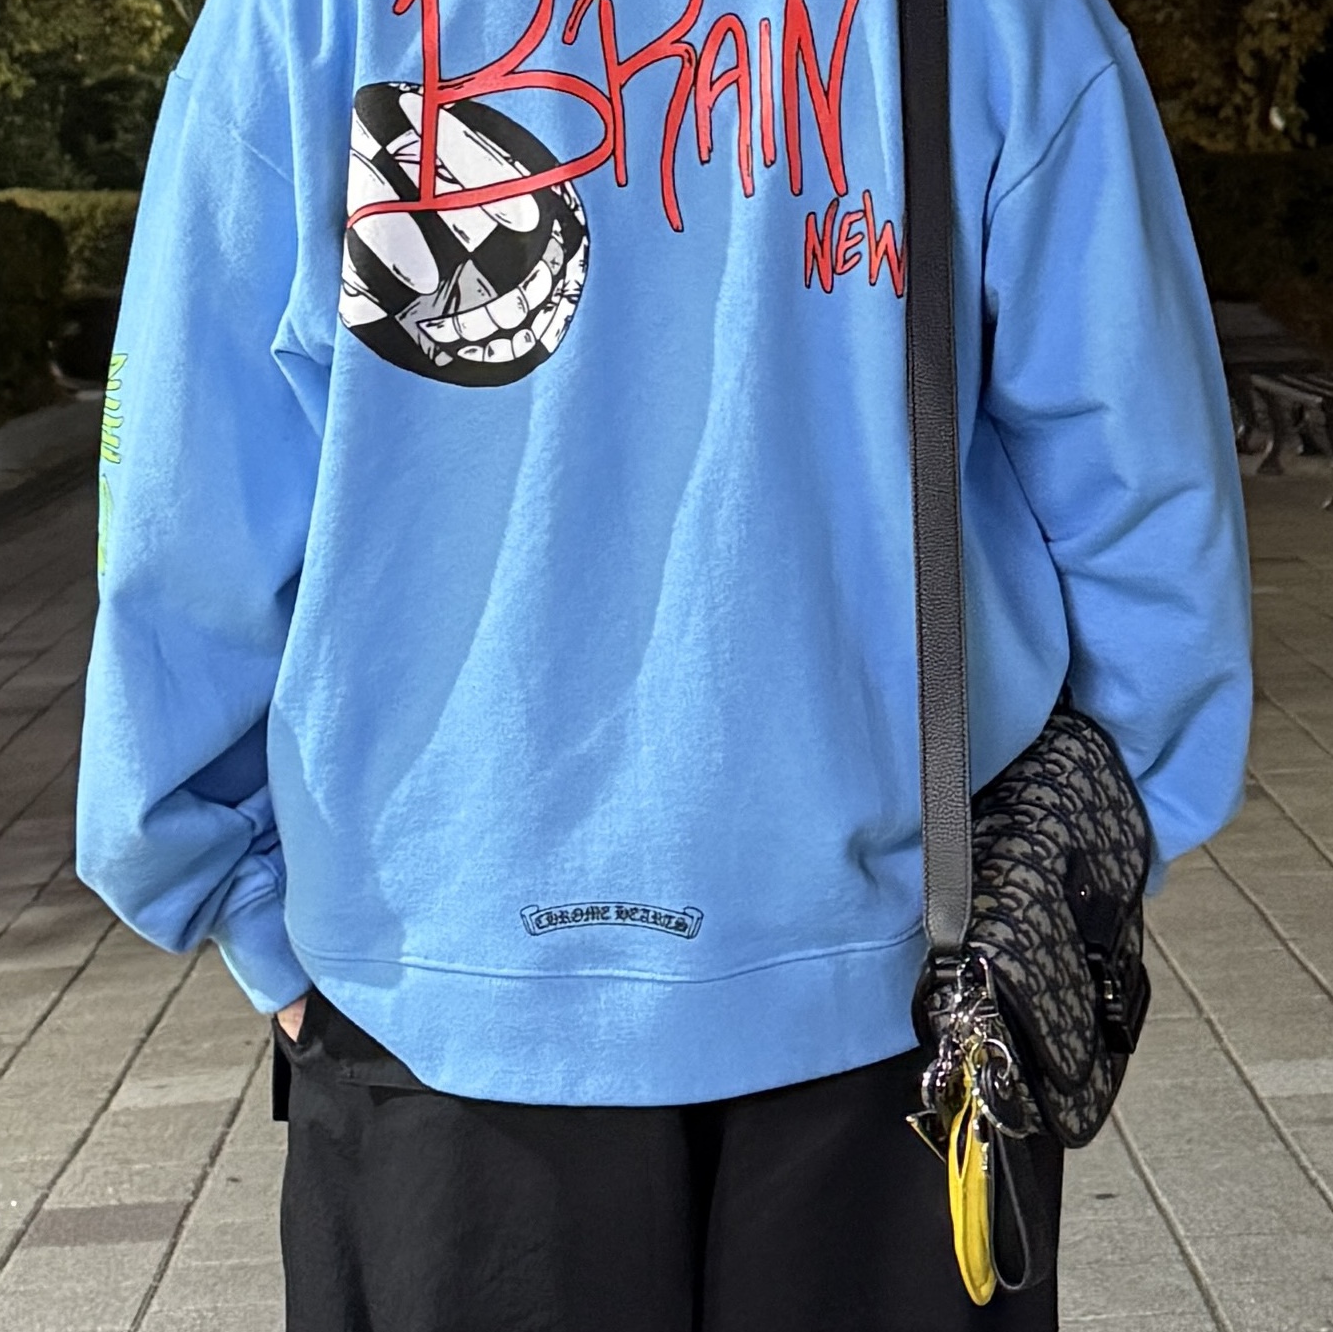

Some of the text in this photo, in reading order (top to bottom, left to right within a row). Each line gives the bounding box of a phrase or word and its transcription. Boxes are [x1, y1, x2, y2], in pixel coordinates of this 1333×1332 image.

[804, 189, 907, 298] NEW
[534, 905, 689, 933] CHROME HEARTS
